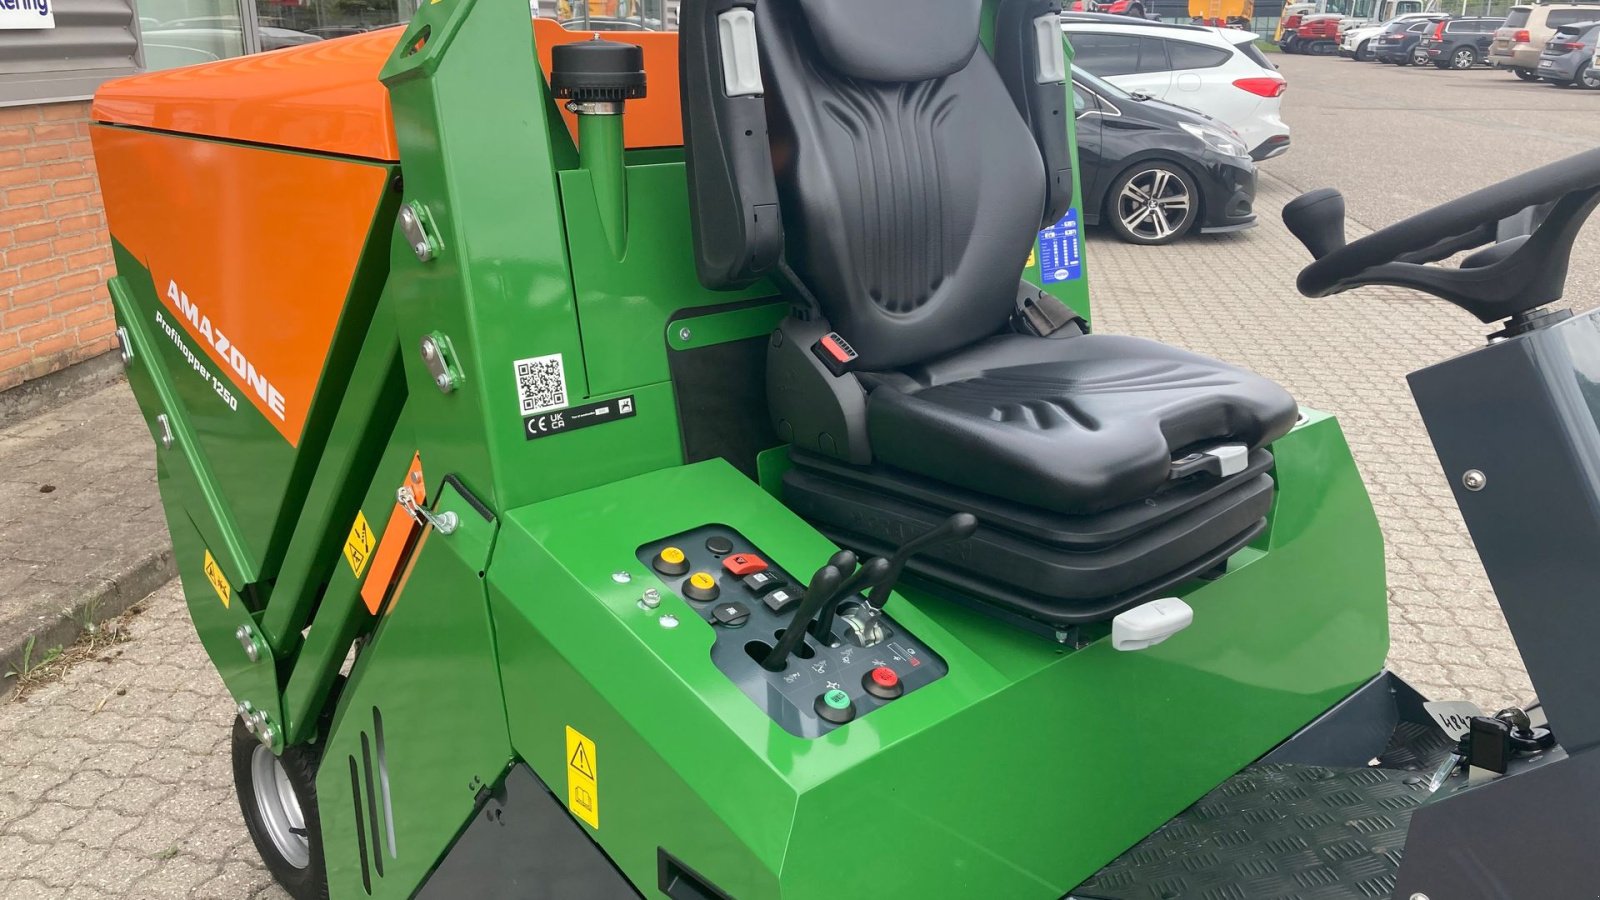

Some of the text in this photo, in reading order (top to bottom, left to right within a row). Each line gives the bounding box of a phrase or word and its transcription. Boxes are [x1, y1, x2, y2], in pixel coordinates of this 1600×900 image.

[167, 279, 285, 422] AMAZONE
[155, 310, 238, 412] Profihopper 1250
[528, 416, 547, 433] CE
[550, 412, 564, 421] UK
[551, 420, 565, 429] CA
